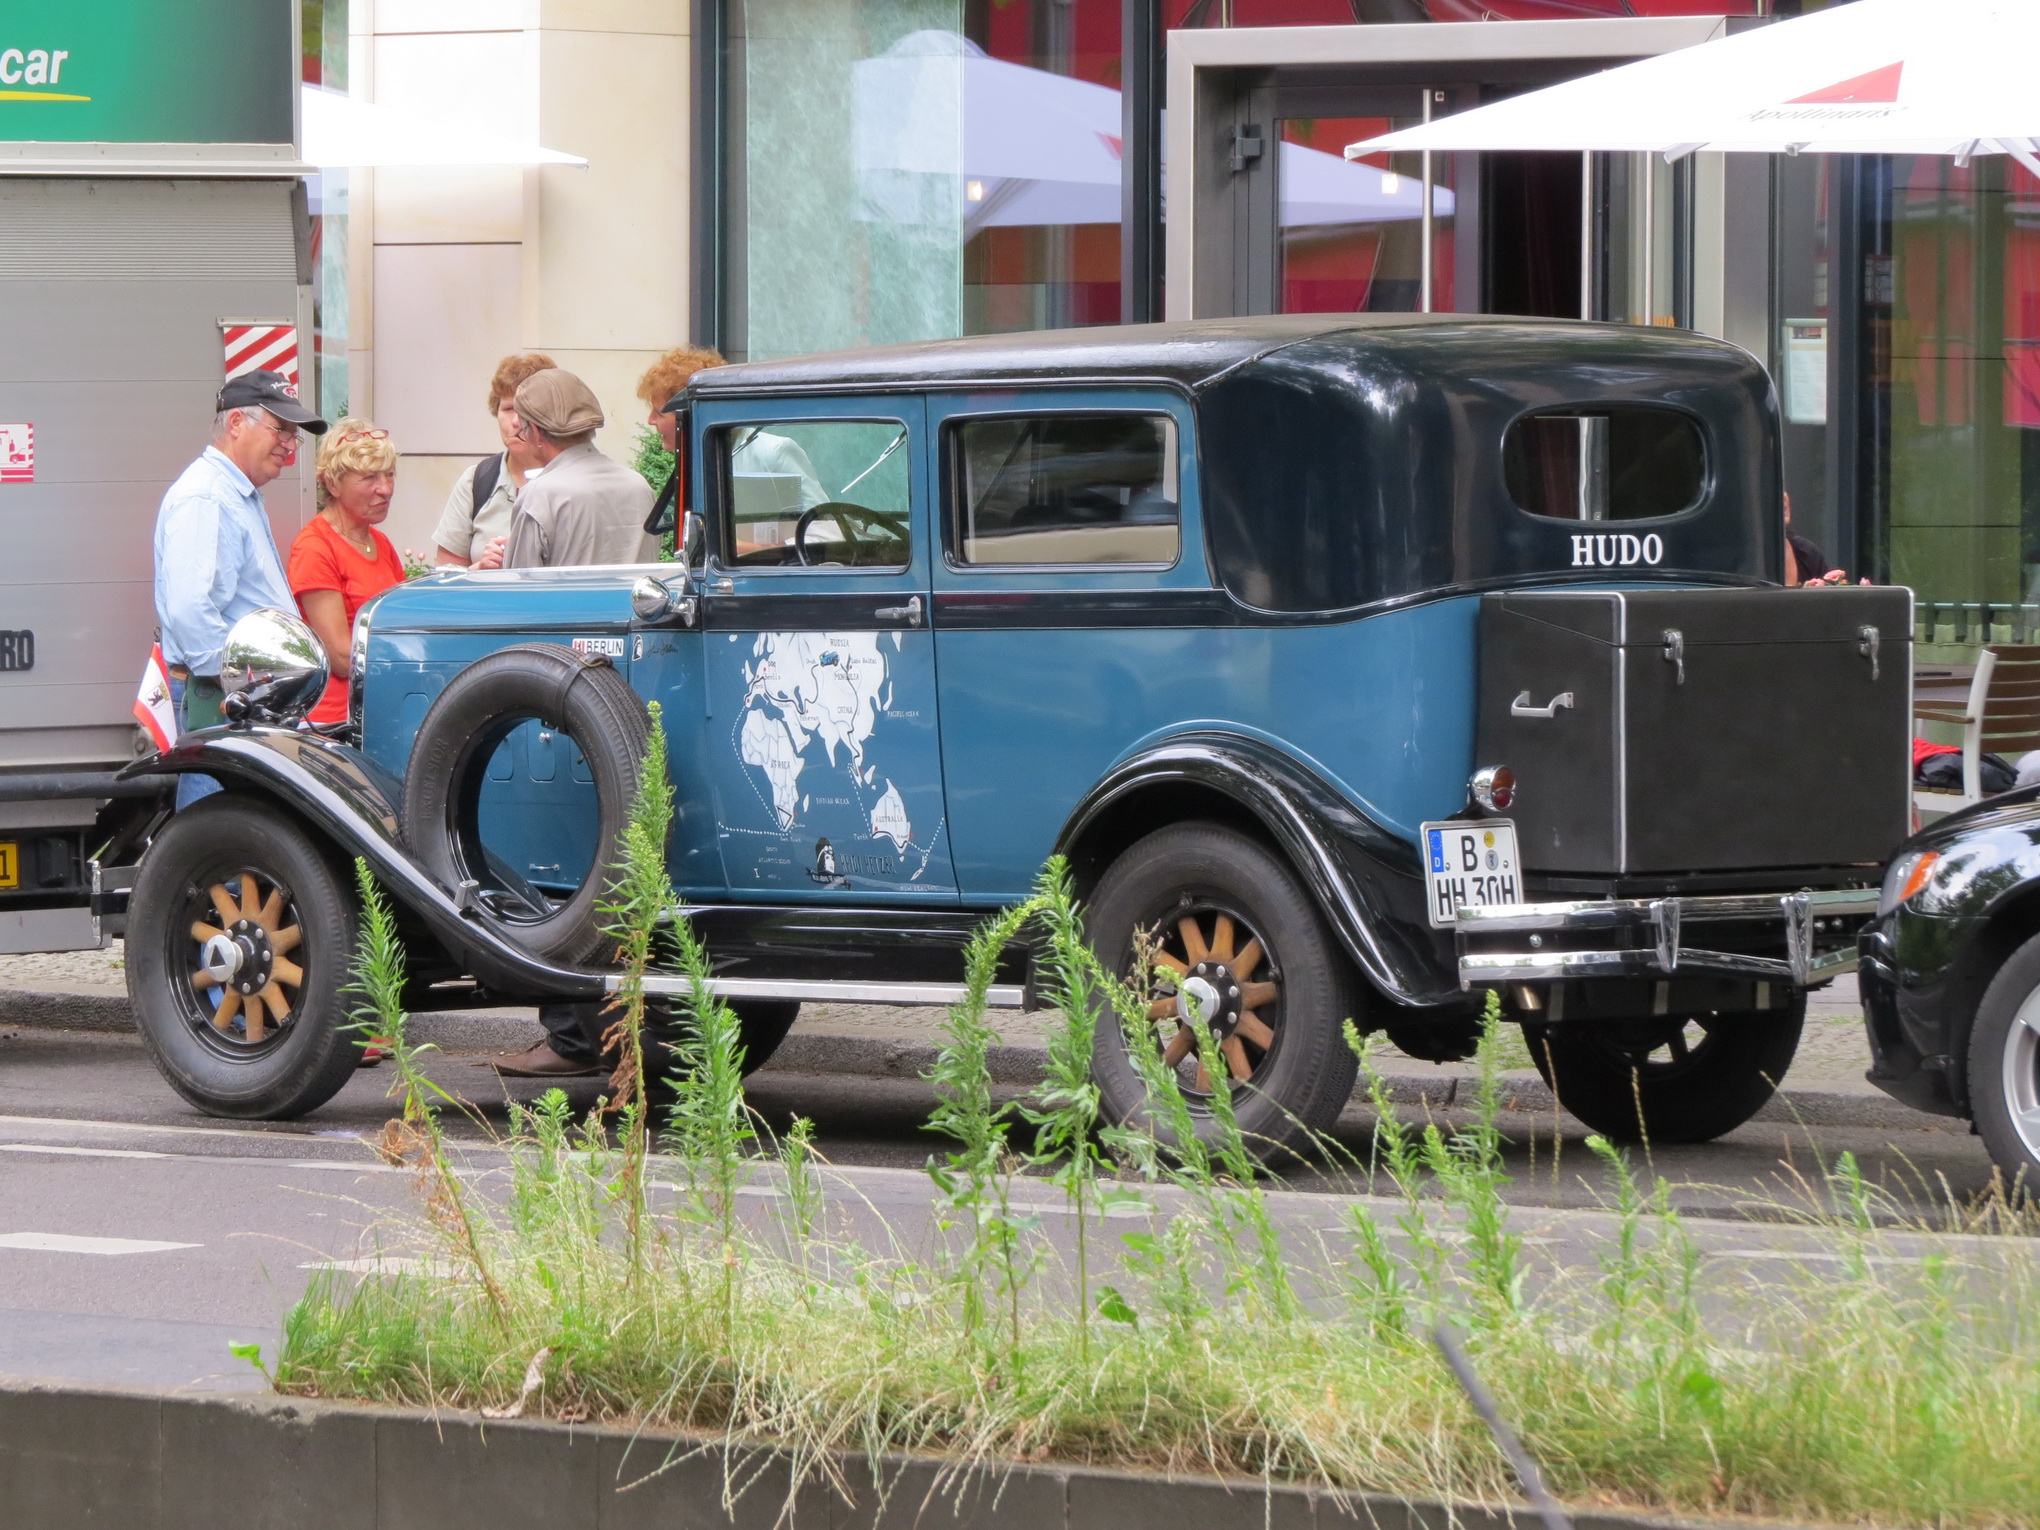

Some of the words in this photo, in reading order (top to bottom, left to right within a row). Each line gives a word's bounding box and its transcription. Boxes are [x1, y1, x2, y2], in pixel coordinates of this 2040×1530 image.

[0, 48, 69, 85] car
[1570, 533, 1664, 566] HUDO
[586, 640, 623, 655] BERLIN
[830, 638, 850, 648] RUSSIA
[837, 706, 854, 714] CHINA
[771, 761, 791, 770] AFRICA
[875, 815, 904, 823] AUSTRALIA
[1461, 835, 1478, 872] B
[840, 854, 864, 874] HEIDI
[864, 855, 898, 876] HETZER
[1434, 857, 1441, 868] D
